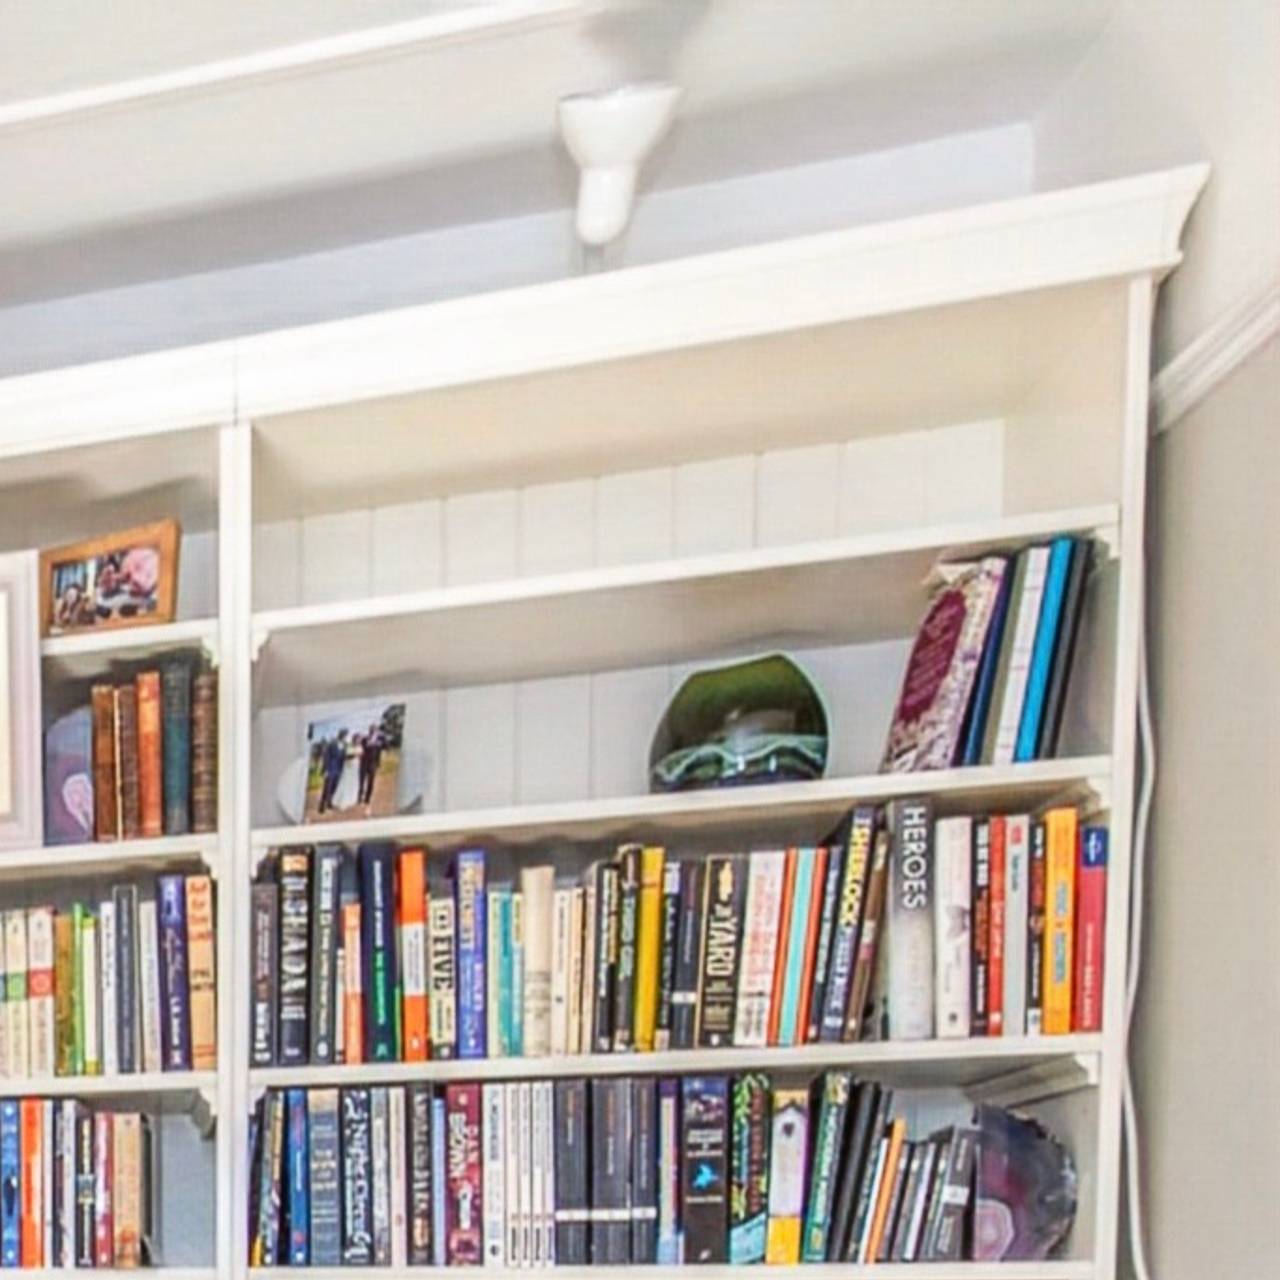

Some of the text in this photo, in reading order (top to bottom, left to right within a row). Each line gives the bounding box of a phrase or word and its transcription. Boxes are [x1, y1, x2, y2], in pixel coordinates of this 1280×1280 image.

[838, 826, 872, 928] SHERLOCK
[903, 806, 927, 909] HEROES
[433, 935, 453, 991] FIVE
[706, 916, 738, 977] YARD
